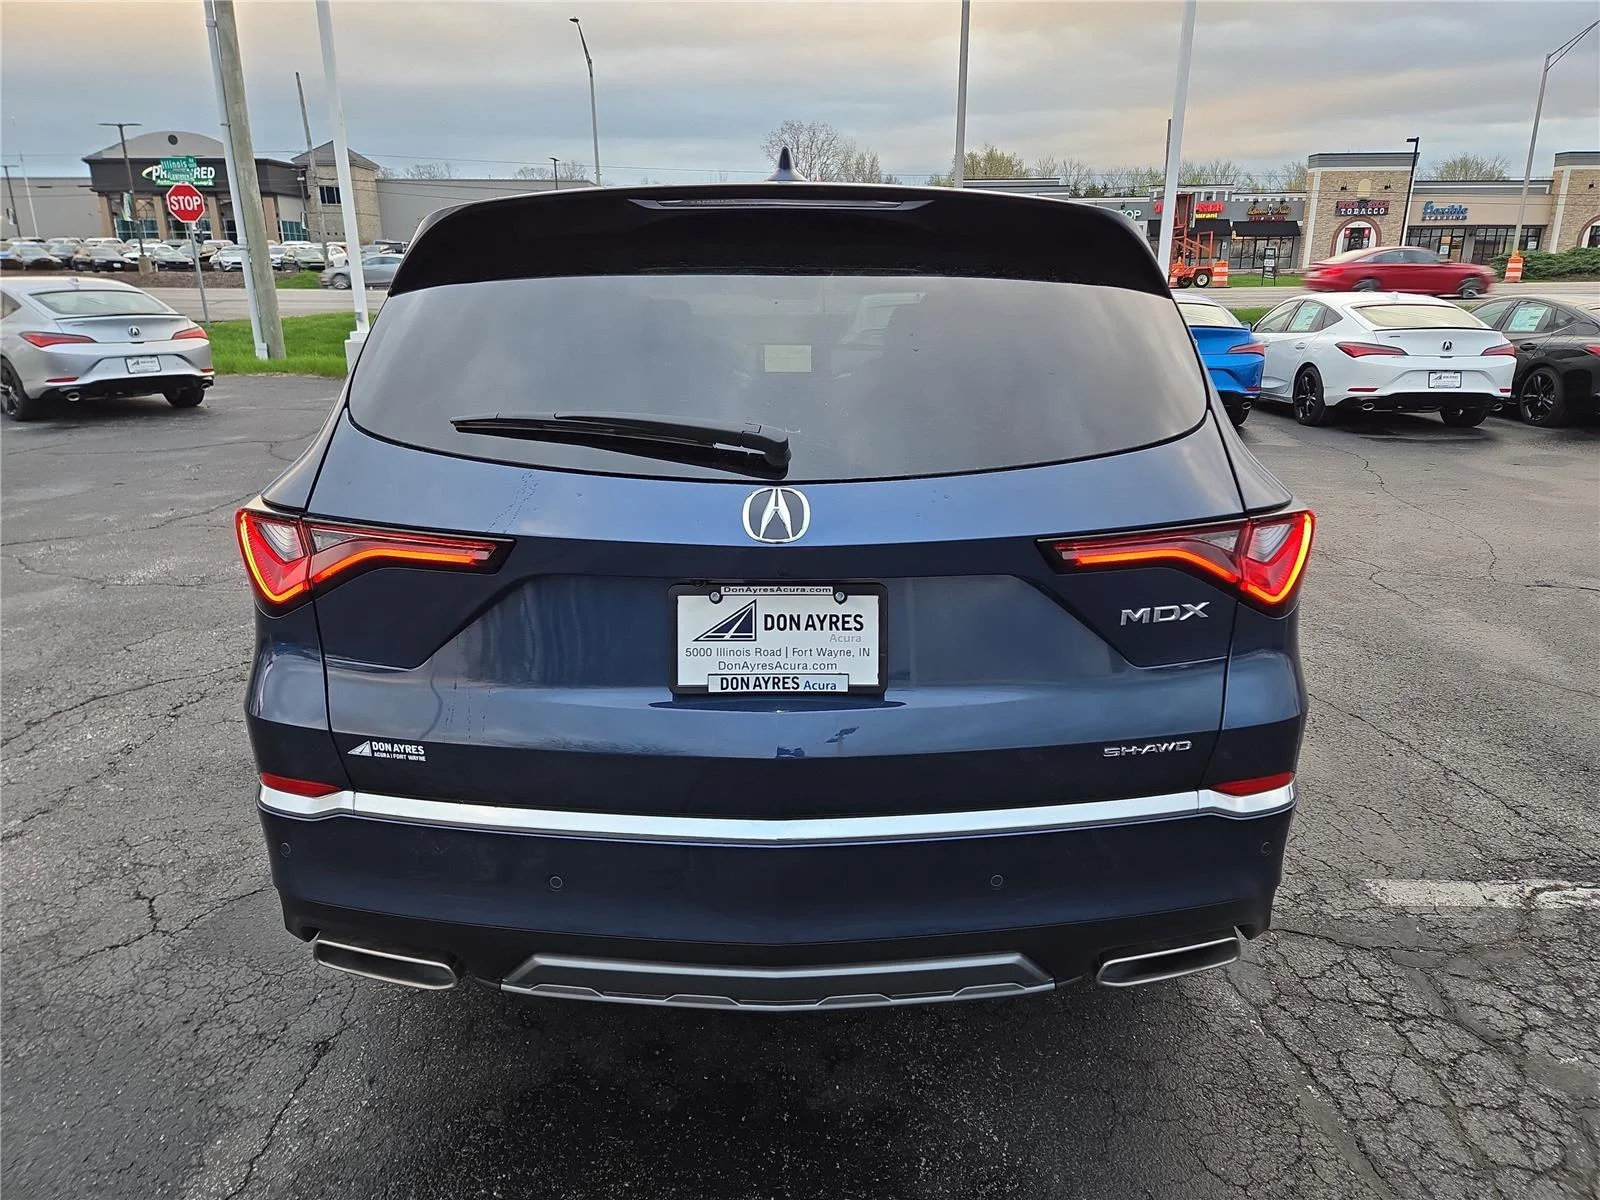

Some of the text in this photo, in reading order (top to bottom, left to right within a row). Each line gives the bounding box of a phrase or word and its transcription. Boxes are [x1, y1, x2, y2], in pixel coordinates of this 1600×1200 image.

[161, 160, 188, 169] Illinois
[170, 195, 201, 211] STOP
[1340, 207, 1386, 215] TOBACCO
[723, 586, 832, 594] DonAyresAcura.com
[1120, 602, 1210, 626] MDX
[763, 613, 864, 632] DON AYRES
[829, 633, 862, 643] Acura
[685, 647, 713, 658] 5000
[716, 647, 751, 658] Illinois
[755, 647, 782, 658] Road
[792, 647, 815, 658] Fort
[816, 647, 855, 659] Wayne,
[859, 648, 870, 658] IN
[718, 661, 838, 673] DonAyresAcura.com
[720, 676, 837, 691] DON AYRES Acura
[371, 741, 425, 755] DON AYRES
